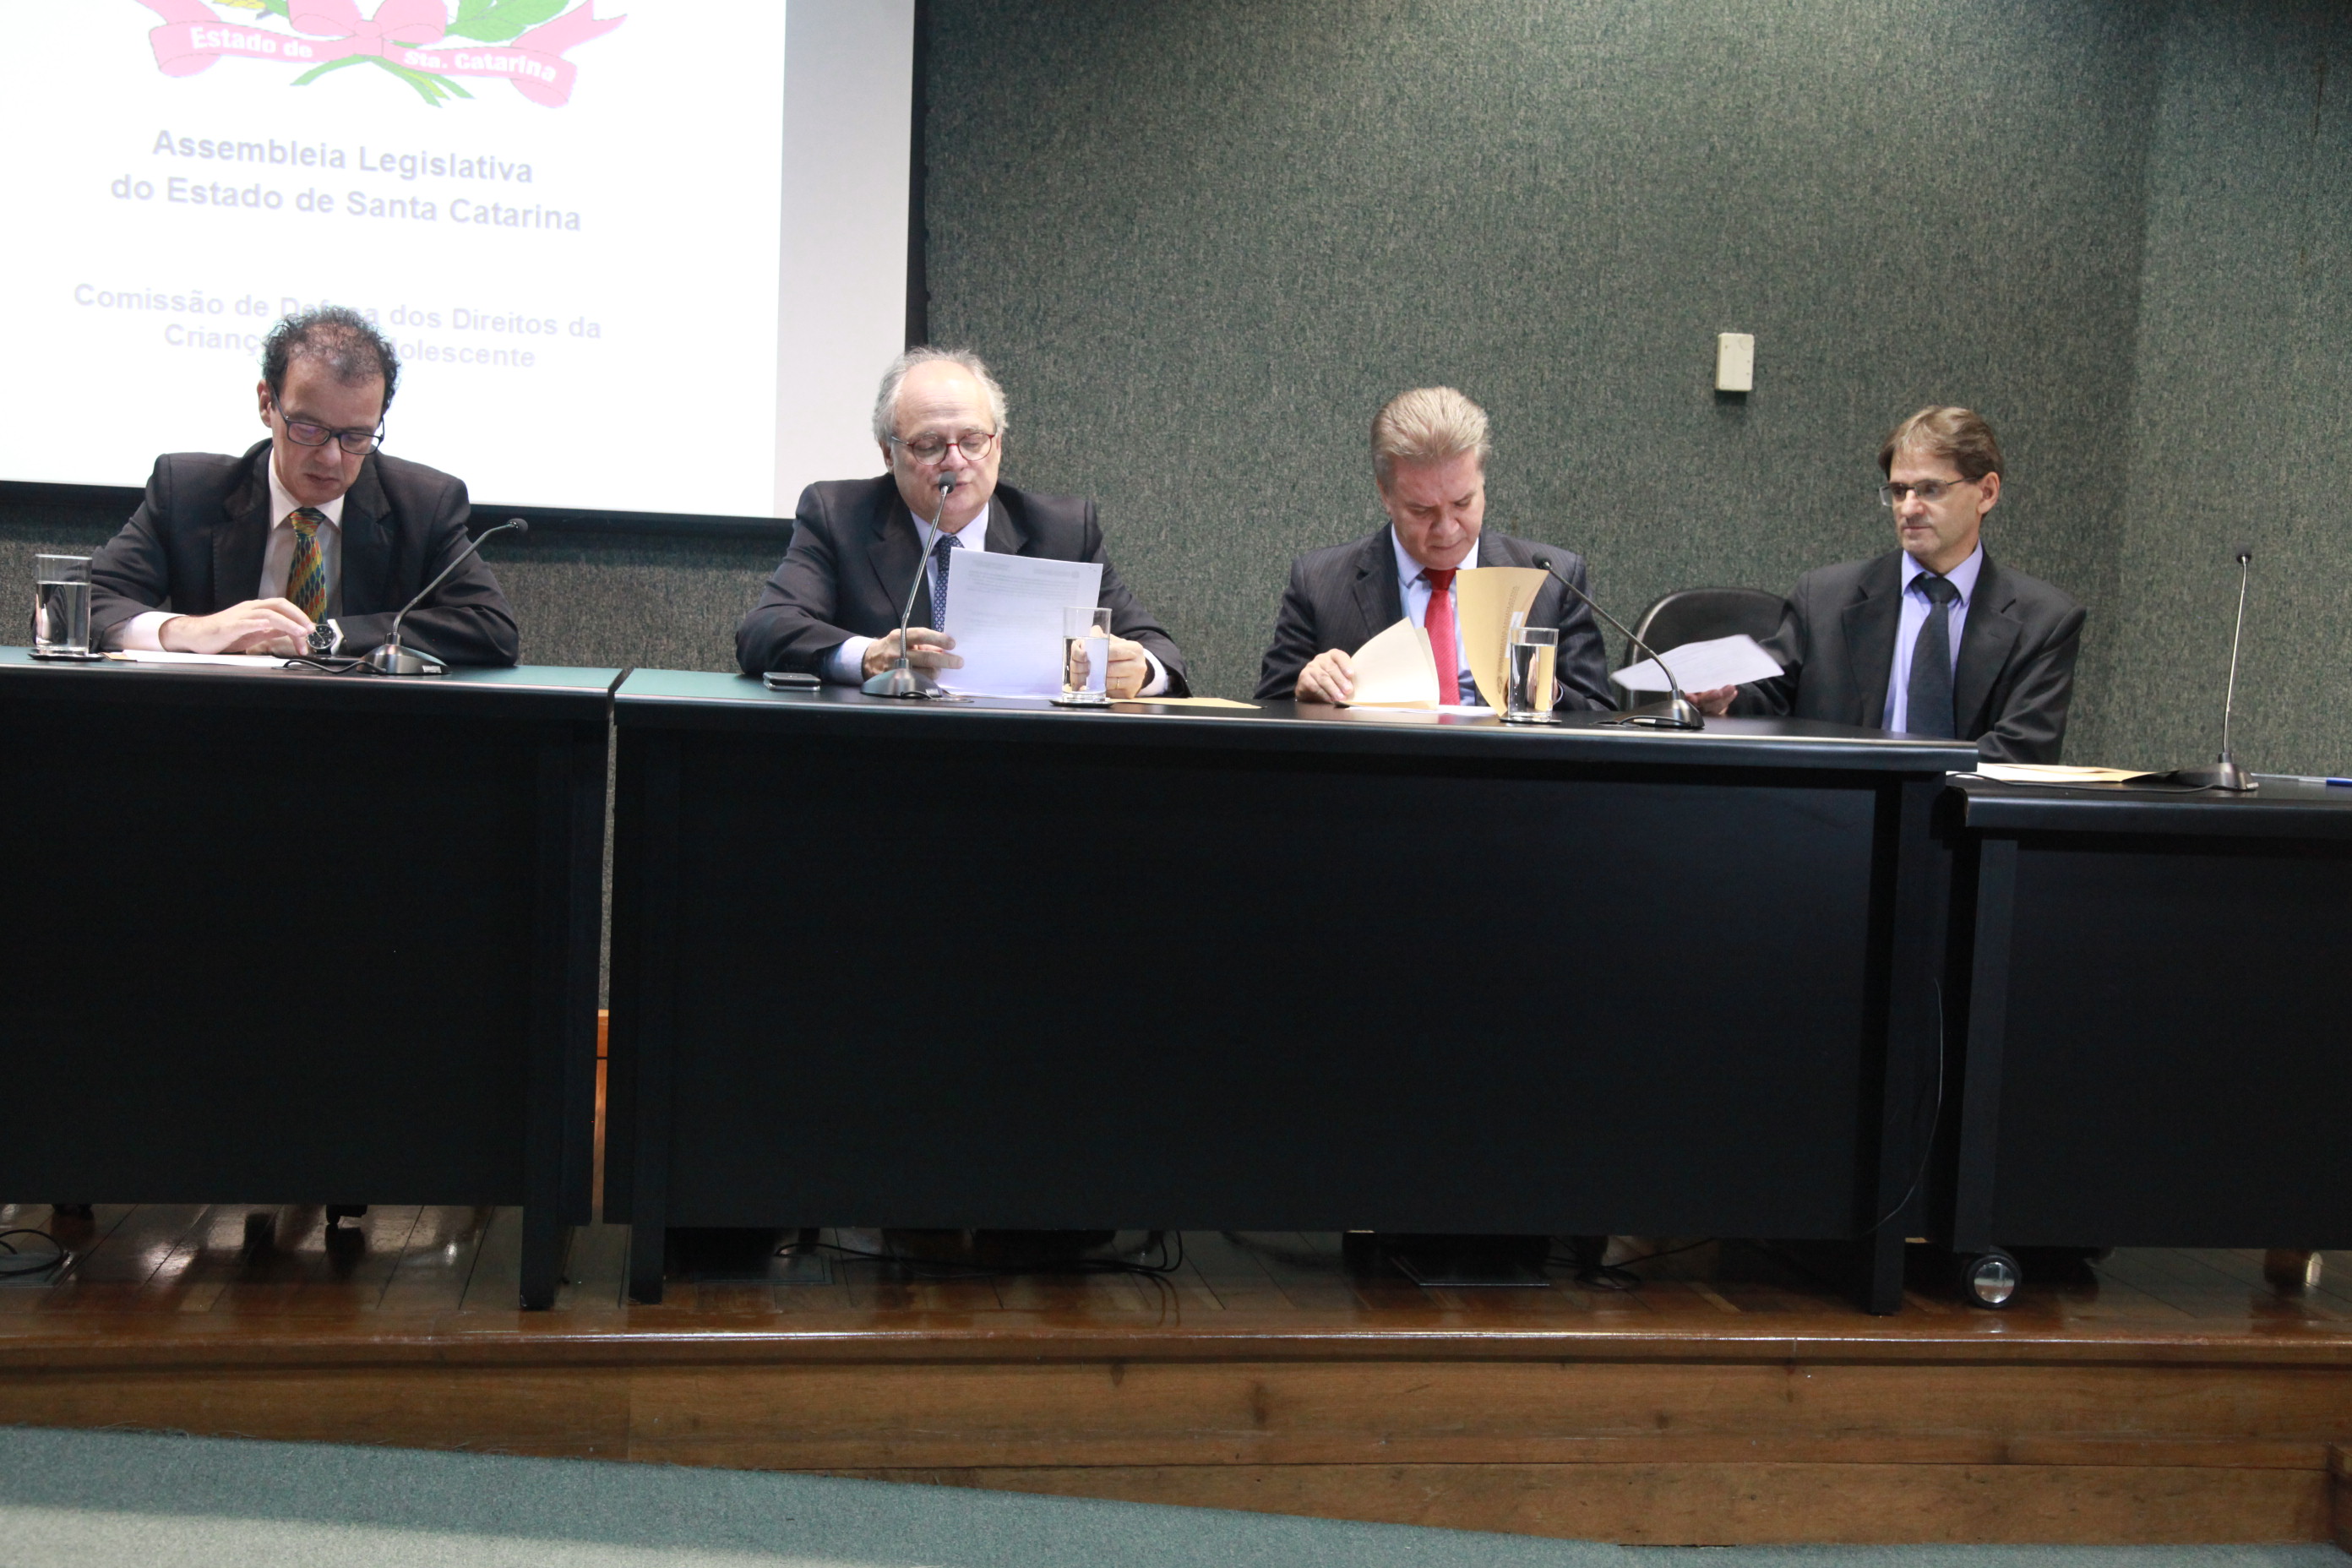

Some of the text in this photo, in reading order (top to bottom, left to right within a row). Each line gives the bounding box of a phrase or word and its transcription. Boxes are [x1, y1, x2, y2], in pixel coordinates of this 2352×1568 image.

[190, 26, 313, 58] Estado de
[404, 50, 557, 82] Sta. Catarina
[152, 129, 534, 184] Assembleia Legislativa
[110, 173, 581, 232] do Estado de Santa Catarina
[74, 282, 225, 316] Comissão
[234, 294, 270, 318] de
[389, 304, 442, 331] dos
[452, 308, 559, 337] Direitos
[568, 318, 602, 340] da
[164, 323, 262, 357] Crianç
